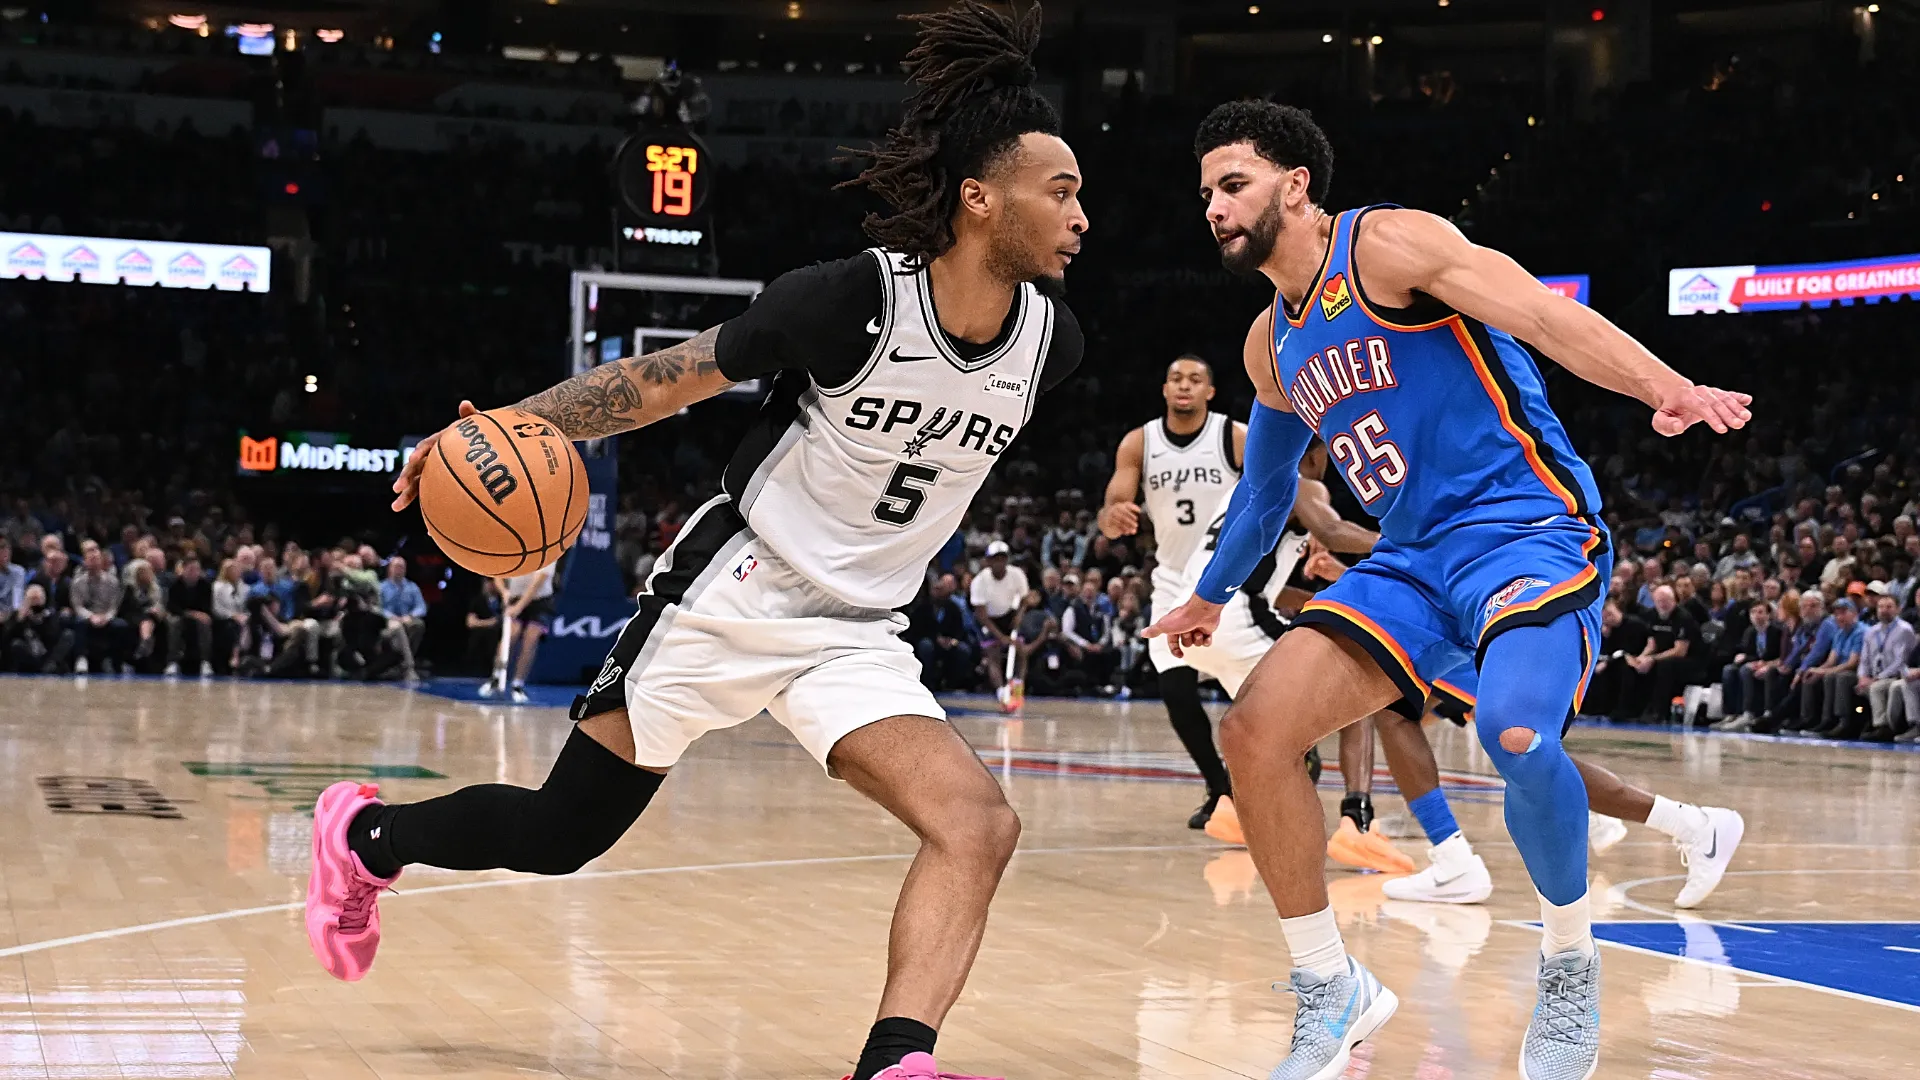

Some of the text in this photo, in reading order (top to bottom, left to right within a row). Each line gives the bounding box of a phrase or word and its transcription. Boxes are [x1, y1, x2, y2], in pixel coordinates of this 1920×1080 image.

[646, 145, 697, 174] 5:27
[653, 171, 692, 216] 19
[644, 227, 703, 246] TISSOT
[1744, 277, 1795, 297] BUILT
[1797, 275, 1832, 295] FOR
[991, 378, 1021, 393] LEDGER
[845, 396, 1014, 459] SPURS
[455, 417, 519, 507] Wilson
[1329, 409, 1408, 506] 25
[1149, 466, 1222, 493] SPURS
[871, 461, 943, 528] 5
[1176, 499, 1196, 526] 3
